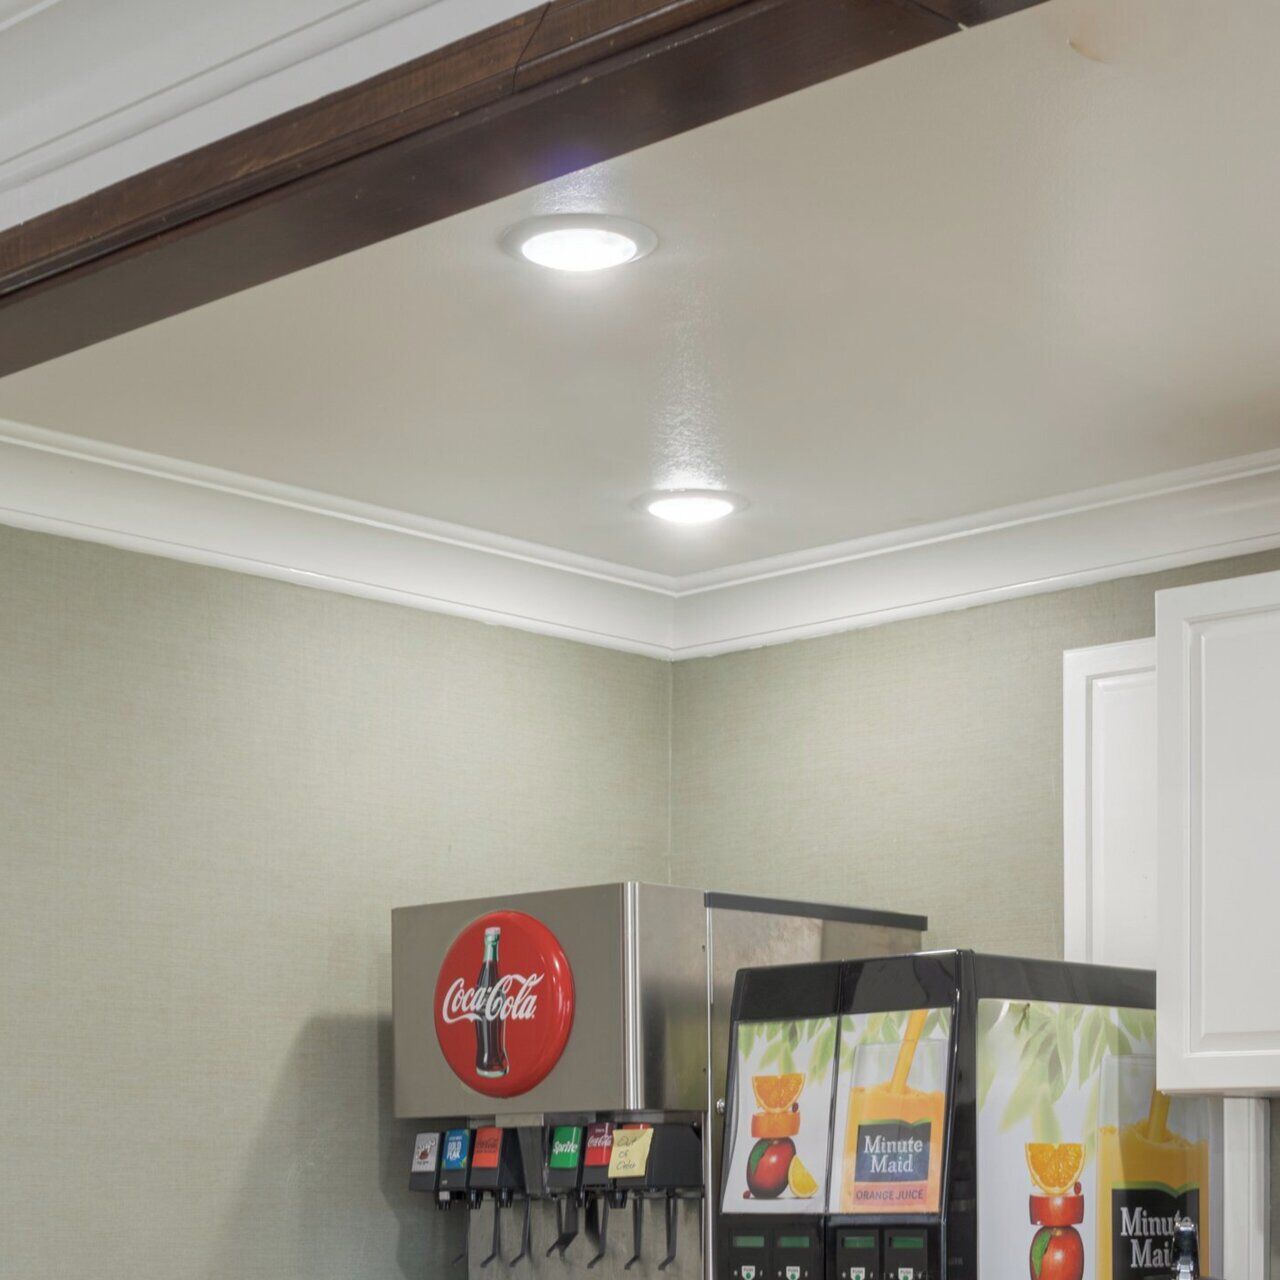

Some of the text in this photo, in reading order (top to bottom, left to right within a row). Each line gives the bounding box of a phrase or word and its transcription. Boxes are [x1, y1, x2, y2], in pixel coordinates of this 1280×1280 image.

[442, 973, 545, 1024] Coca-Cola
[553, 1141, 578, 1155] Sprite
[863, 1135, 923, 1154] Minute
[870, 1154, 914, 1173] Maid
[856, 1189, 924, 1200] ORANGE JUICE
[1130, 1238, 1172, 1268] Mai
